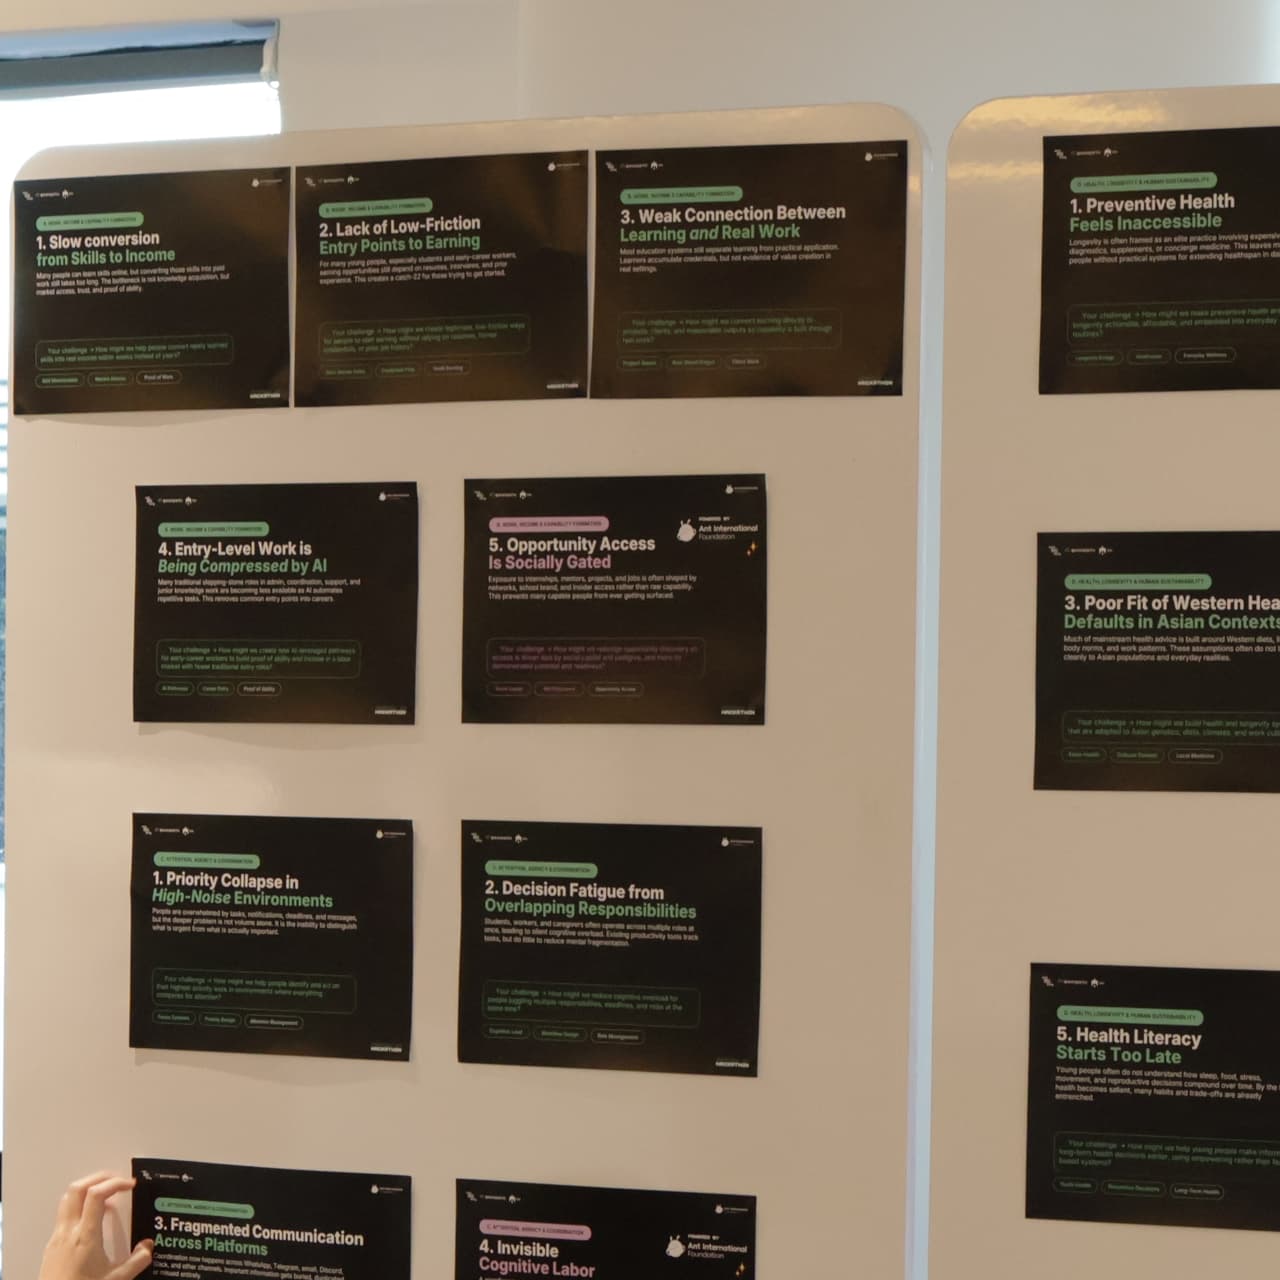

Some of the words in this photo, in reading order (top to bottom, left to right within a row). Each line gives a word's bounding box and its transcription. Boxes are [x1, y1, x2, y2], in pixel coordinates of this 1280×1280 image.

[1069, 197, 1083, 214] 1.
[1085, 194, 1177, 214] Preventive
[1179, 191, 1235, 210] Health
[619, 208, 635, 225] 3.
[637, 207, 682, 224] Weak
[683, 205, 774, 223] Connection
[776, 204, 846, 220] Between
[1069, 215, 1114, 233] Feels
[1116, 211, 1222, 231] Inaccessible
[318, 221, 333, 238] 2.
[335, 220, 370, 237] Lack
[372, 218, 388, 235] of
[389, 215, 481, 234] Low-Friction
[619, 225, 686, 244] Learning
[688, 224, 720, 241] and
[721, 223, 755, 240] Real
[757, 222, 801, 239] Work
[35, 234, 47, 250] 1.
[48, 233, 82, 250] Slow
[83, 230, 160, 248] conversion
[318, 239, 358, 257] Entry
[360, 236, 406, 253] Points
[407, 236, 423, 251] to
[425, 233, 481, 251] Earning
[35, 251, 69, 267] from
[70, 249, 107, 266] Skills
[108, 249, 123, 264] to
[124, 248, 176, 263] Income
[157, 540, 172, 556] 4.
[174, 540, 256, 558] Entry-Level
[257, 540, 297, 556] Work
[298, 539, 312, 556] is
[488, 536, 504, 553] 5.
[506, 535, 597, 554] Opportunity
[599, 535, 656, 551] Access
[157, 558, 197, 575] Being
[198, 557, 289, 575] Compressed
[290, 557, 309, 575] by
[311, 557, 327, 573] AI
[488, 554, 503, 570] Is
[504, 553, 564, 571] Socially
[565, 553, 612, 569] Gated
[1063, 594, 1081, 611] 3.
[1084, 594, 1124, 611] Poor
[1126, 593, 1149, 611] Fit
[1150, 593, 1169, 611] of
[1171, 594, 1245, 611] Western
[1063, 612, 1135, 629] Defaults
[1137, 612, 1154, 629] in
[1156, 612, 1205, 629] Asian
[152, 869, 164, 885] 1.
[165, 870, 219, 890] Priority
[220, 872, 283, 891] Collapse
[284, 873, 299, 890] in
[484, 878, 499, 895] 2.
[501, 879, 567, 897] Decision
[568, 881, 626, 901] Fatigue
[627, 883, 665, 900] from
[151, 887, 232, 906] High-Noise
[233, 889, 334, 908] Environments
[483, 896, 575, 918] Overlapping
[577, 899, 697, 919] Responsibilities
[1056, 1025, 1073, 1042] 5.
[1075, 1025, 1130, 1044] Health
[1132, 1027, 1202, 1050] Literacy
[1055, 1043, 1107, 1061] Starts
[1109, 1045, 1142, 1063] Too
[1144, 1046, 1182, 1064] Late
[153, 1215, 168, 1231] 3.
[169, 1216, 251, 1238] Fragmented
[251, 1223, 364, 1246] Communication
[152, 1233, 202, 1250] Across
[204, 1236, 269, 1257] Platforms
[478, 1238, 494, 1254] 4.
[496, 1238, 559, 1258] Invisible
[478, 1256, 550, 1276] Cognitive
[551, 1260, 596, 1278] Labor
